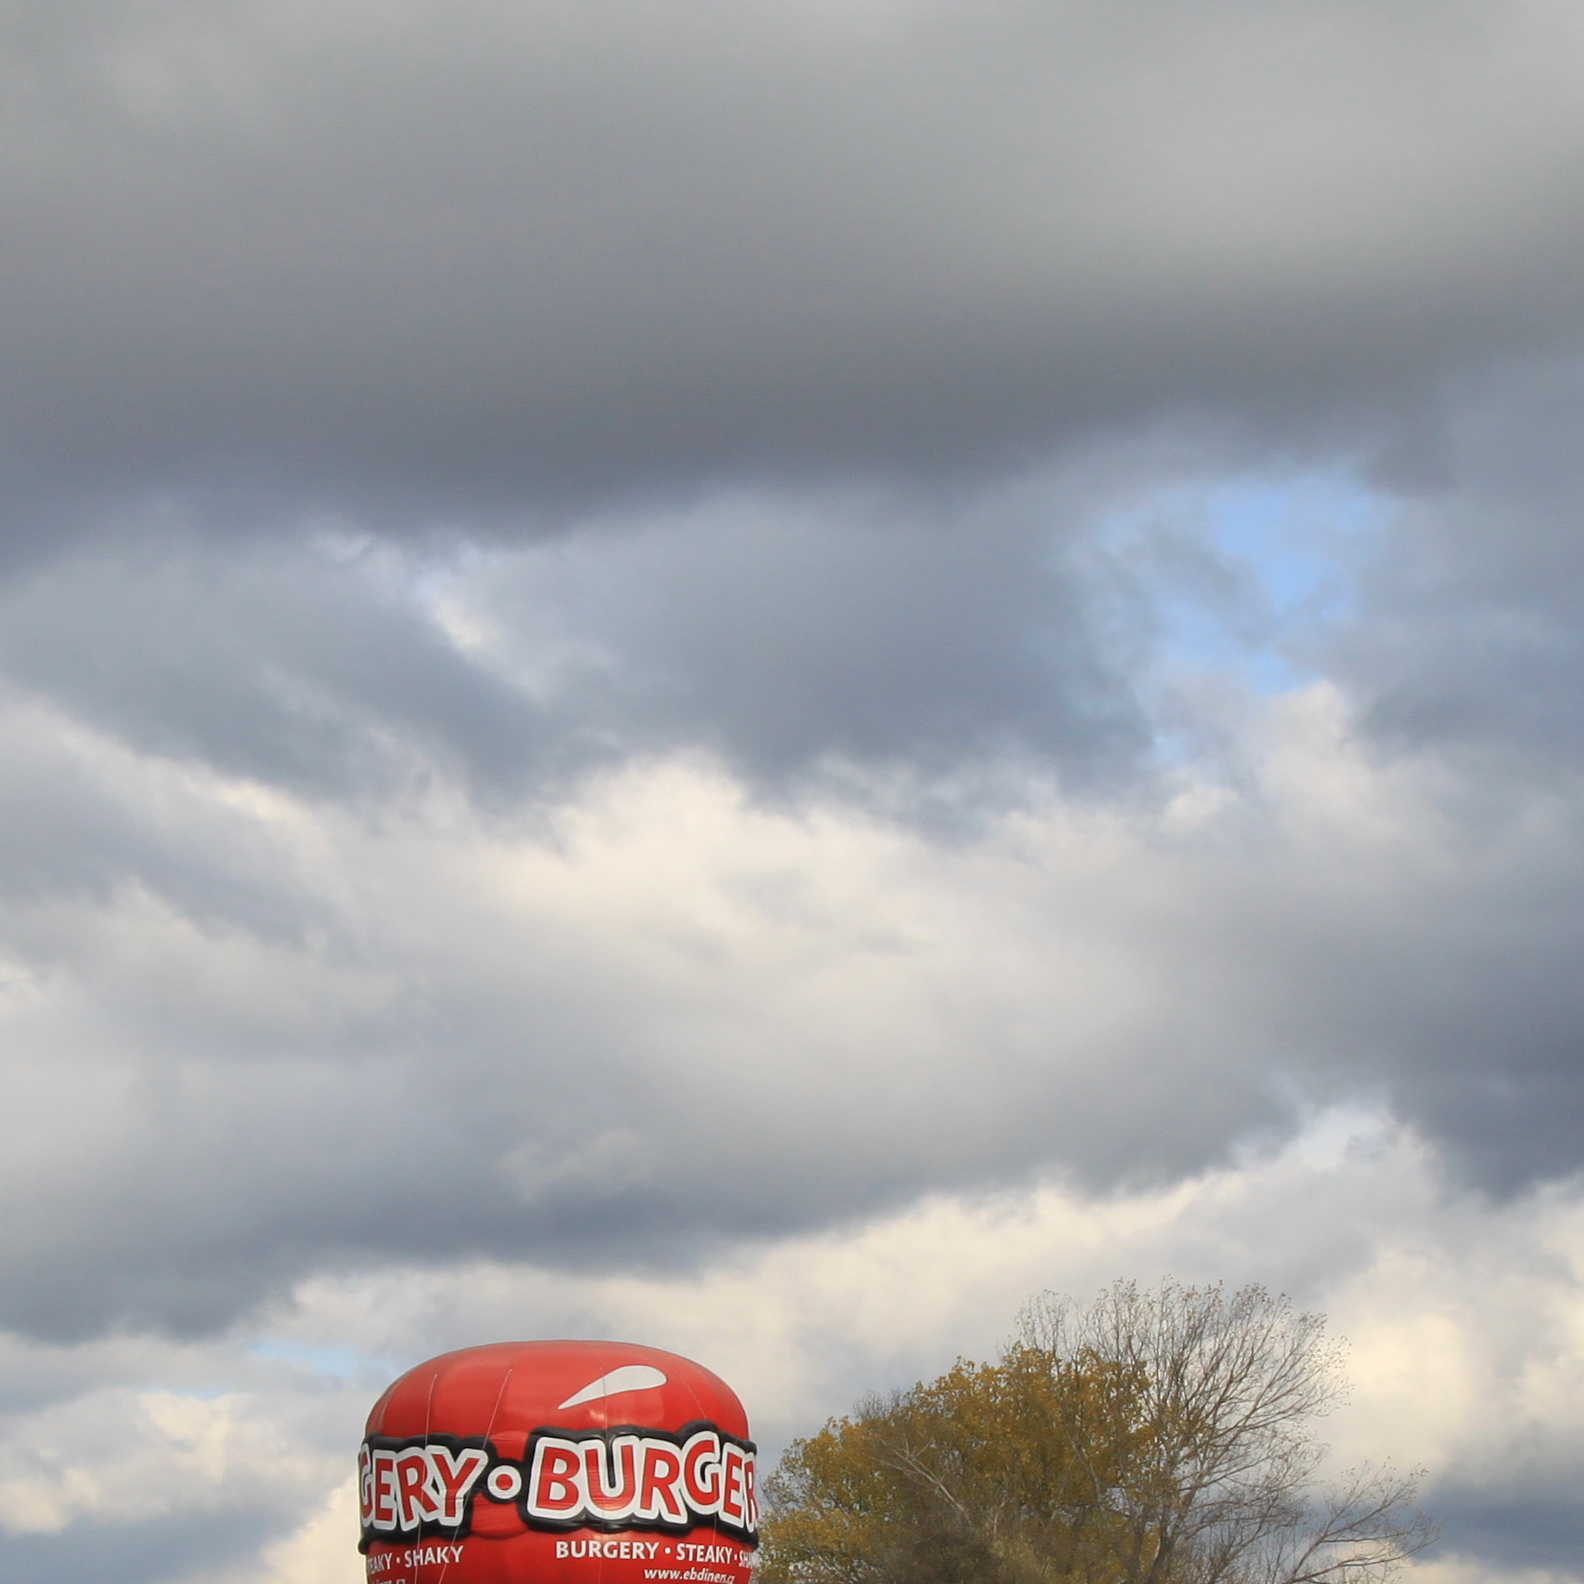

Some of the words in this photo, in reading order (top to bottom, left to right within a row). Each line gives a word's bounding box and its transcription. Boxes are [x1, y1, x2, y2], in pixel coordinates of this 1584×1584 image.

[404, 1545, 464, 1568] SHAKY
[555, 1540, 660, 1560] BURGERY
[676, 1543, 733, 1564] STEAKY
